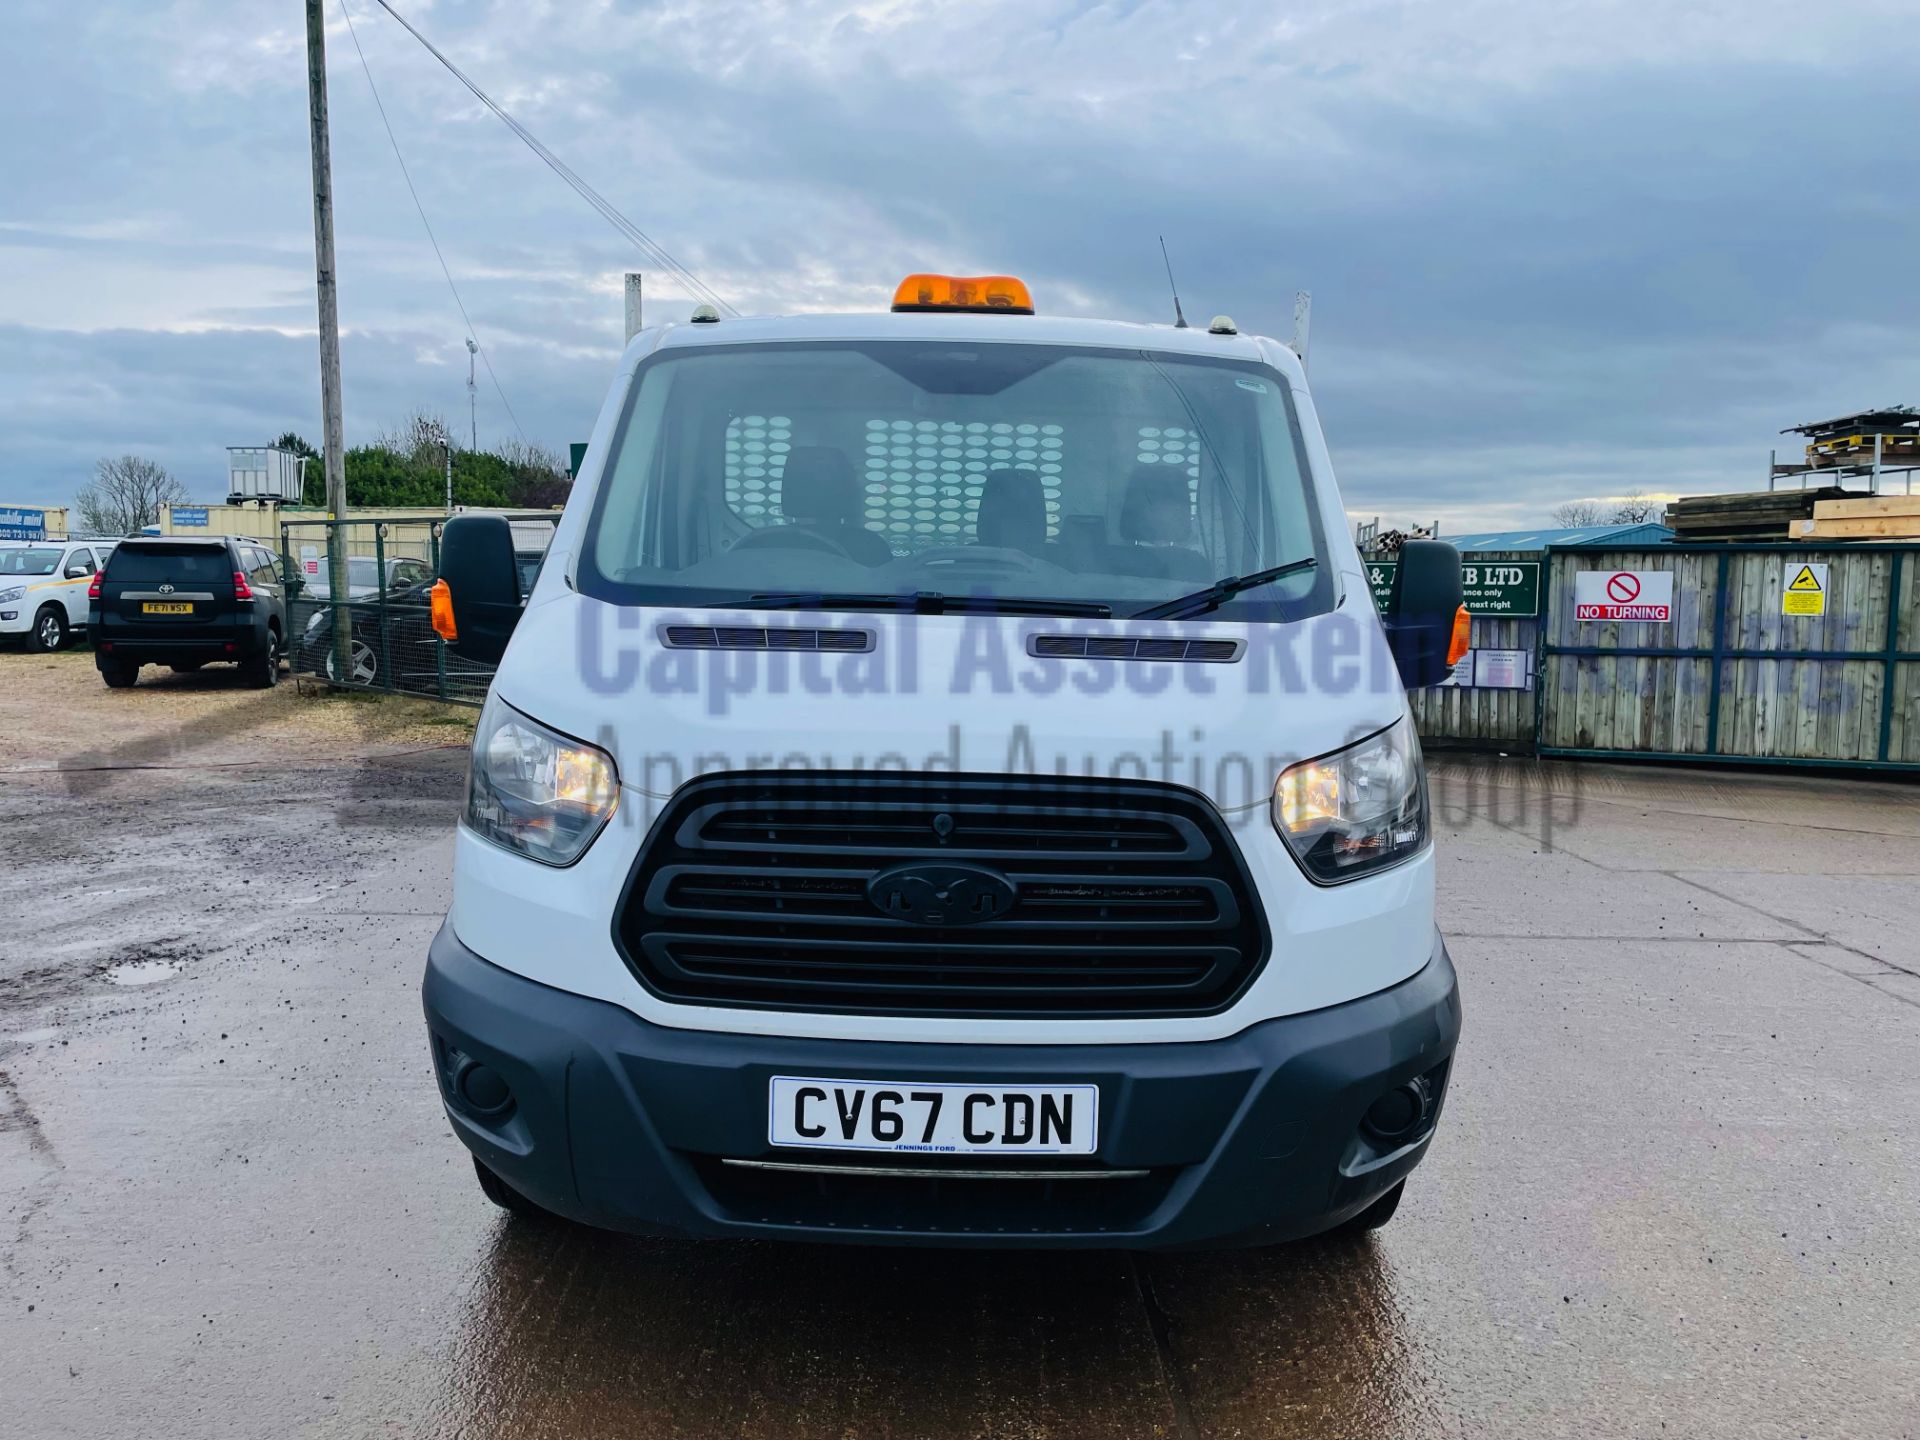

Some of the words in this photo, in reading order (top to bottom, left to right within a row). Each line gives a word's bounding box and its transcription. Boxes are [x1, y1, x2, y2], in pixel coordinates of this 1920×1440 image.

[0, 511, 22, 525] obile
[1371, 567, 1384, 585] &
[1484, 567, 1524, 586] LTD
[1375, 588, 1391, 596] deli
[1484, 589, 1502, 598] only
[1470, 601, 1488, 609] next
[1490, 601, 1511, 610] right
[1580, 606, 1600, 618] NO
[1605, 606, 1666, 619] TURNING
[795, 1087, 943, 1143] CV67
[963, 1093, 1073, 1145] CDN
